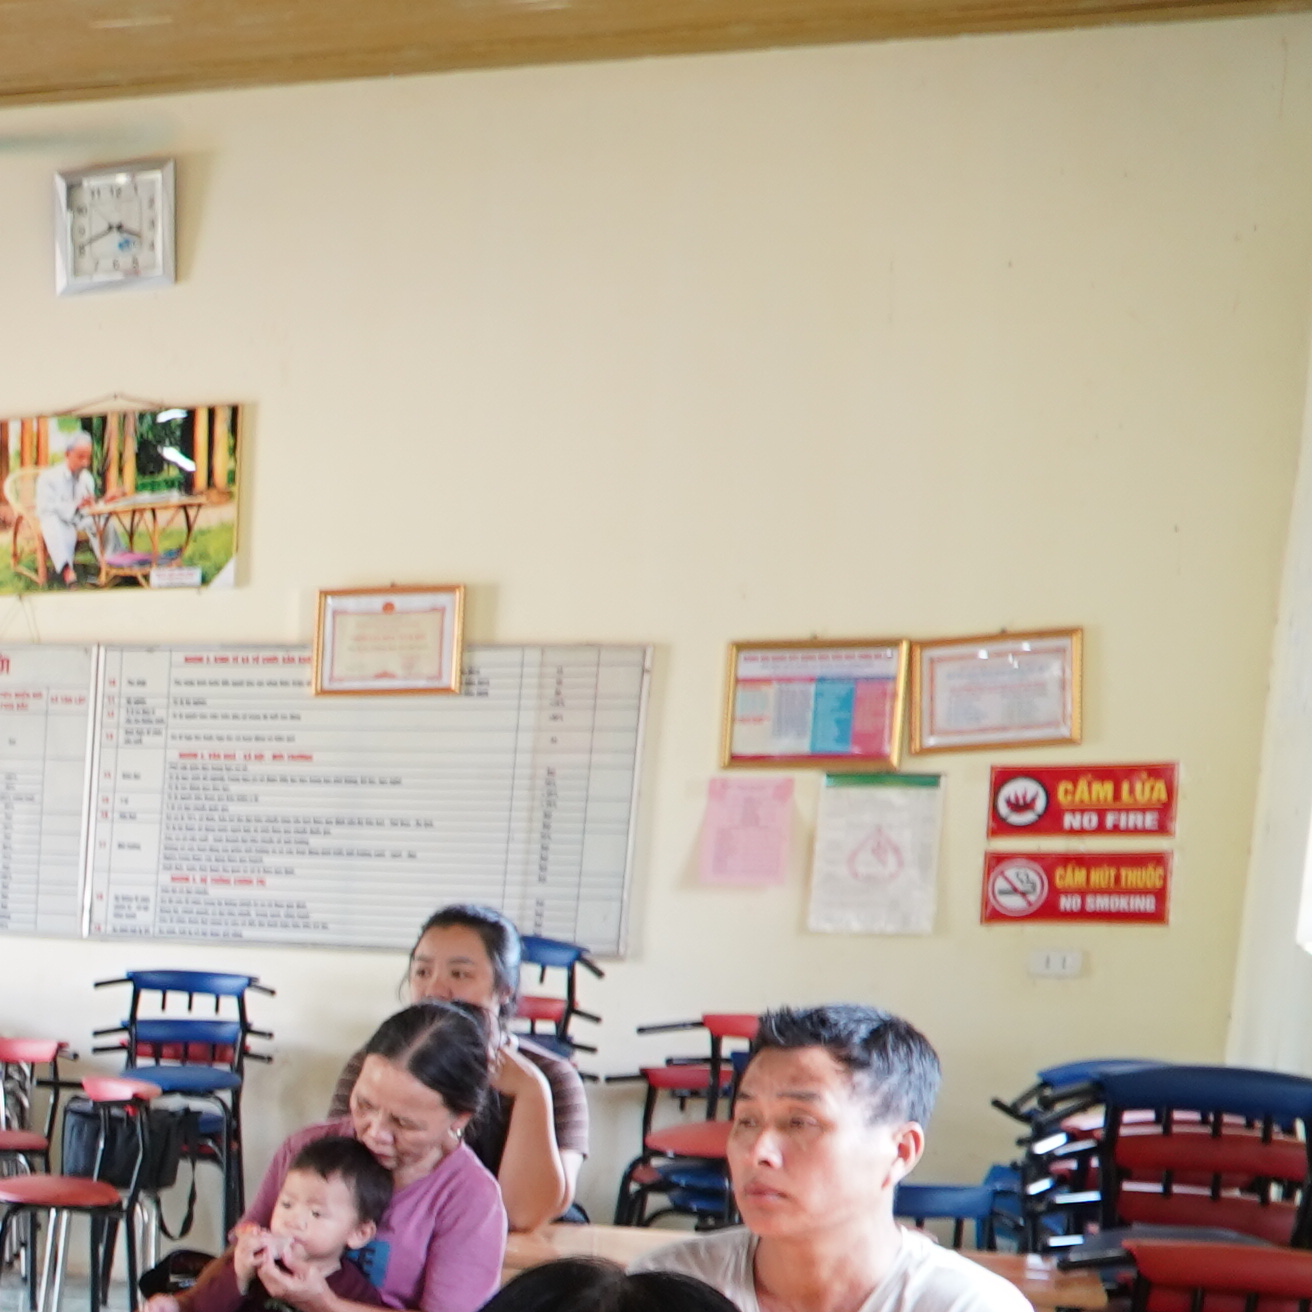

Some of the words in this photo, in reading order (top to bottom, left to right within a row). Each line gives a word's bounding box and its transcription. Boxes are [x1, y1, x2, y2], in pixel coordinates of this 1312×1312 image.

[1057, 773, 1115, 805] CẤM
[1122, 771, 1169, 805] LỬA
[1063, 811, 1099, 831] NO
[1105, 811, 1159, 831] FIRE
[1055, 862, 1087, 889] CẤM
[1090, 865, 1116, 889] HÚT
[1059, 894, 1082, 912] NO
[1085, 894, 1156, 913] SMOKING
